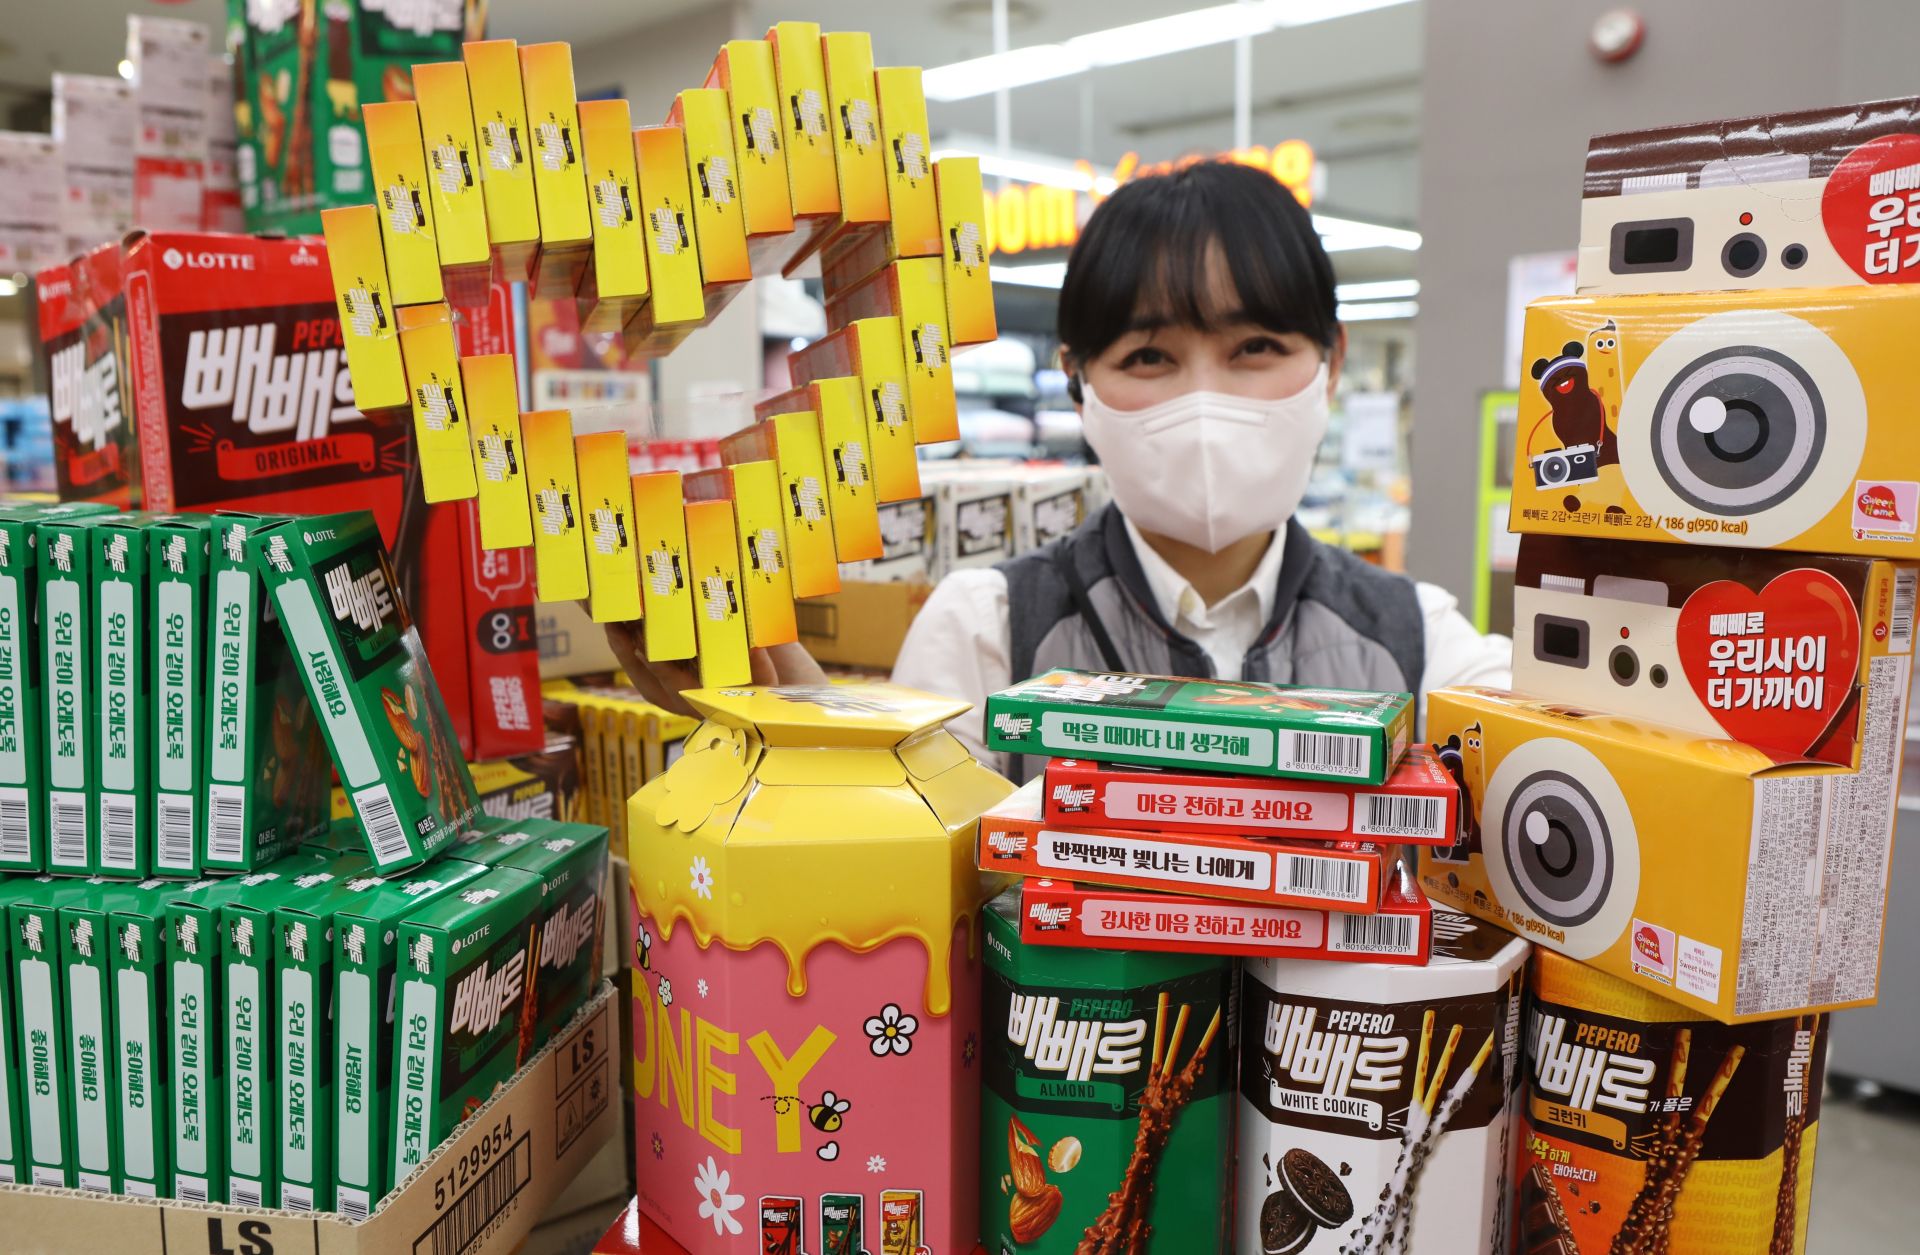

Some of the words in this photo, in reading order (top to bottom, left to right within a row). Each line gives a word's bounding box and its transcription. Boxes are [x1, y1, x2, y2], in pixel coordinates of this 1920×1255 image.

[187, 252, 255, 270] LOTTE
[255, 439, 343, 472] ORIGINAL
[1862, 494, 1895, 509] Sweet
[1865, 505, 1895, 518] Home
[312, 529, 336, 542] LOTTE
[1523, 508, 1549, 520] 빼빼로
[1603, 514, 1633, 527] 빼빼로
[1636, 515, 1651, 528] 2갑
[1665, 518, 1684, 530] 186
[1687, 519, 1718, 533] g(950
[1721, 520, 1748, 535] kcal)
[54, 611, 73, 646] 우리
[108, 612, 126, 647] 우리
[166, 613, 184, 648] 우리
[223, 602, 241, 636] 우리
[1709, 612, 1765, 636] 빼빼로
[55, 651, 74, 685] 같이
[108, 652, 126, 686] 같이
[166, 653, 184, 687] 같이
[221, 641, 240, 675] 같이
[307, 650, 347, 719] 사랑해요
[57, 689, 75, 757] 오래도록
[108, 691, 127, 759] 오래도록
[166, 692, 184, 759] 오래도록
[219, 682, 239, 750] 오래도록
[1062, 721, 1100, 744] 먹을
[1104, 726, 1162, 748] 때마다
[1166, 730, 1186, 750] 내
[1190, 732, 1250, 756] 생각해
[1137, 793, 1178, 813] 마음
[1184, 796, 1245, 817] 전하고
[1251, 800, 1313, 821] 싶어요
[1052, 841, 1127, 867] 반짝반짝
[1133, 849, 1190, 874] 빛나는
[1196, 856, 1255, 880] 너에게
[548, 870, 570, 891] LOTTE
[462, 924, 490, 949] LOTTE
[1101, 910, 1152, 932] 감사한
[1156, 913, 1189, 933] 마음
[1194, 916, 1245, 936] 전하고
[1251, 918, 1302, 939] 싶어요
[1512, 911, 1524, 926] 186
[1525, 918, 1546, 936] g(950
[1548, 926, 1565, 944] kcal)
[1637, 932, 1658, 950] Sweet
[992, 940, 1013, 962] LOTTE
[1639, 943, 1660, 959] Home
[450, 948, 526, 1036] 빼빼로
[1069, 998, 1134, 1019] PEPERO
[180, 993, 197, 1029] 우리
[234, 995, 251, 1032] 우리
[289, 1000, 306, 1037] 우리
[1327, 1009, 1395, 1035] PEPERO
[409, 1012, 427, 1050] 우리
[1008, 992, 1147, 1082] 빼빼로
[1575, 1023, 1641, 1054] PEPERO
[31, 1029, 50, 1096] 좋아해요
[181, 1034, 198, 1068] 같이
[235, 1036, 252, 1072] 같이
[288, 1041, 305, 1077] 같이
[570, 1028, 595, 1075] LS
[1264, 1000, 1410, 1098] 빼빼로
[1528, 1006, 1657, 1114] 빼빼로
[79, 1034, 98, 1102] 좋아해요
[126, 1039, 144, 1109] 좋아해요
[345, 1041, 363, 1114] 사랑해요
[406, 1054, 425, 1088] 같이
[1784, 1030, 1811, 1117] 빼빼로
[182, 1072, 199, 1142] 오래도록
[1040, 1081, 1096, 1099] ALMOND
[1280, 1091, 1319, 1112] WHITE
[1323, 1097, 1369, 1118] COOKIE
[1650, 1100, 1661, 1112] 가
[1663, 1097, 1693, 1112] 품은
[236, 1075, 253, 1144] 오래도록
[289, 1080, 305, 1151] 오래도록
[1548, 1106, 1587, 1129] 크런키
[403, 1093, 423, 1165] 오래도록
[434, 1114, 513, 1211] 5129954
[1550, 1148, 1571, 1163] 하게
[1552, 1163, 1597, 1182] 태어났다!
[207, 1217, 274, 1255] LS
